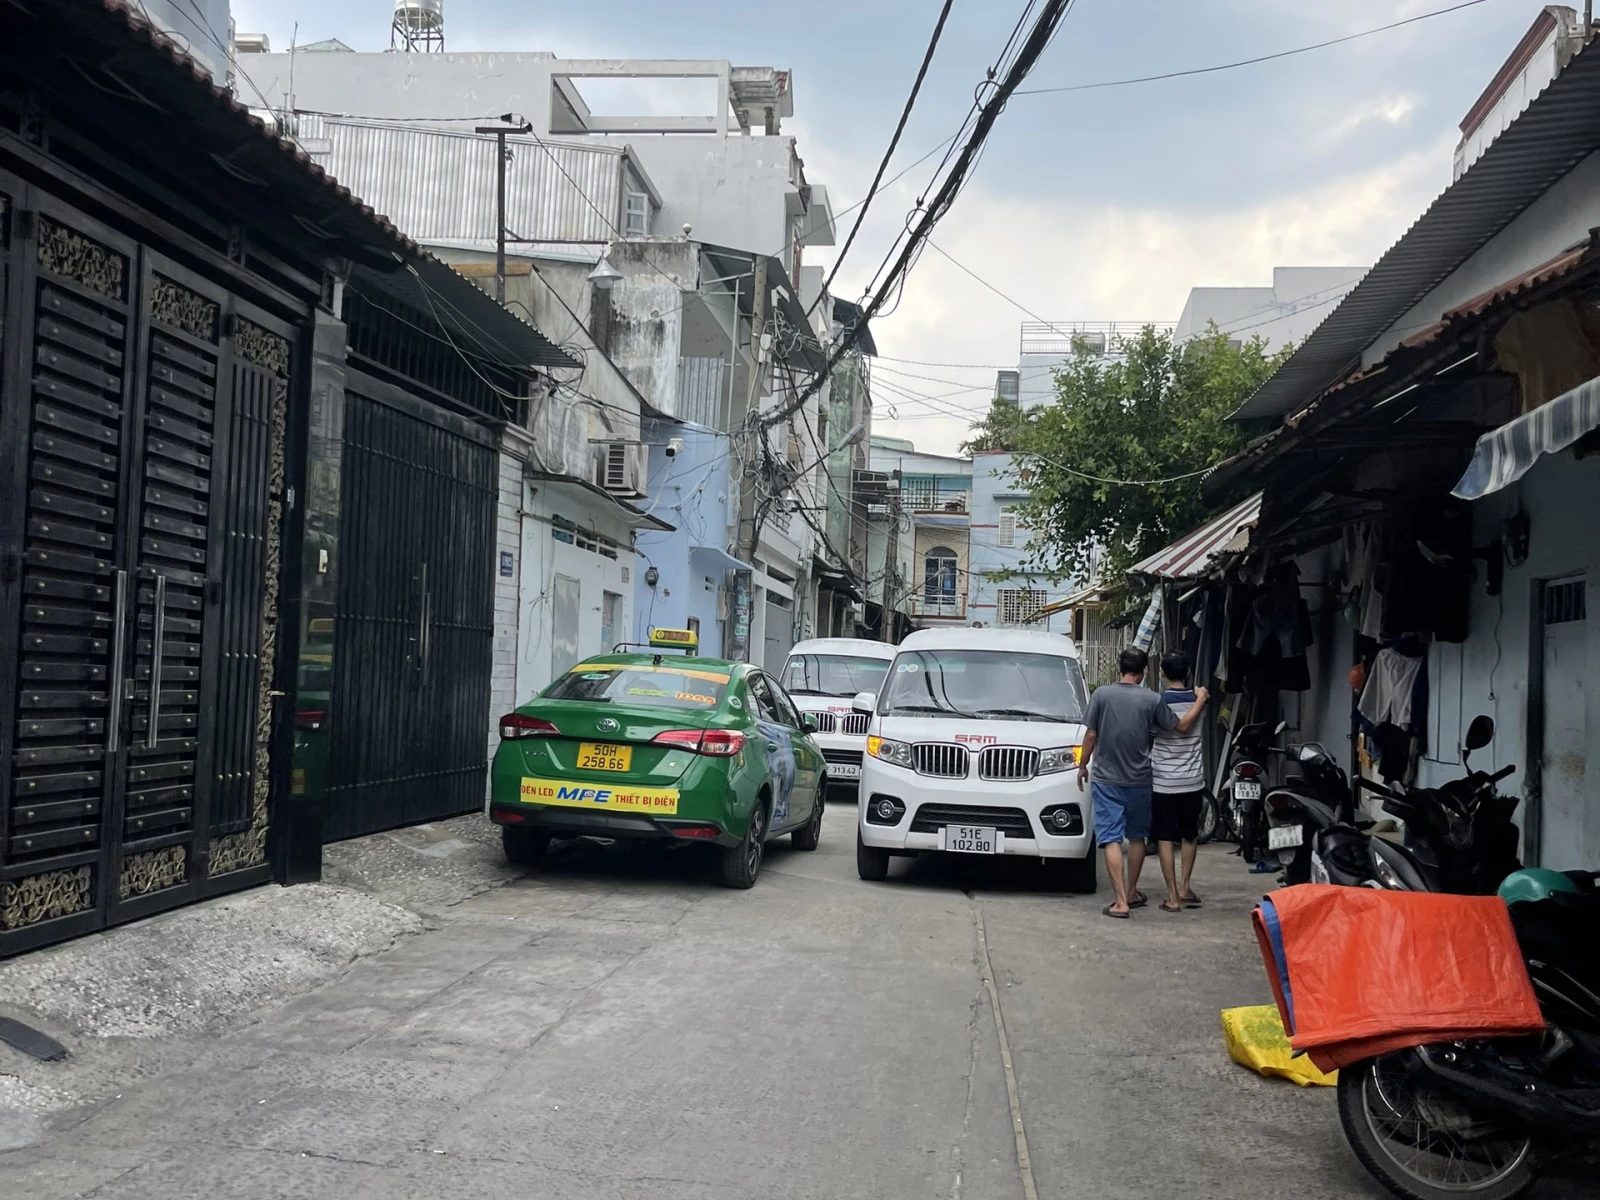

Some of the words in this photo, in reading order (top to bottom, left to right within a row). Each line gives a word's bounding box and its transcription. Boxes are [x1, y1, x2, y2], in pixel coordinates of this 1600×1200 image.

[954, 734, 997, 744] SRM
[593, 744, 617, 757] 50H
[582, 755, 624, 769] 258.66
[538, 787, 554, 797] LED
[556, 786, 612, 803] MPE
[615, 792, 641, 805] THIẾT
[960, 828, 982, 840] 51E
[952, 840, 991, 852] 102.80
